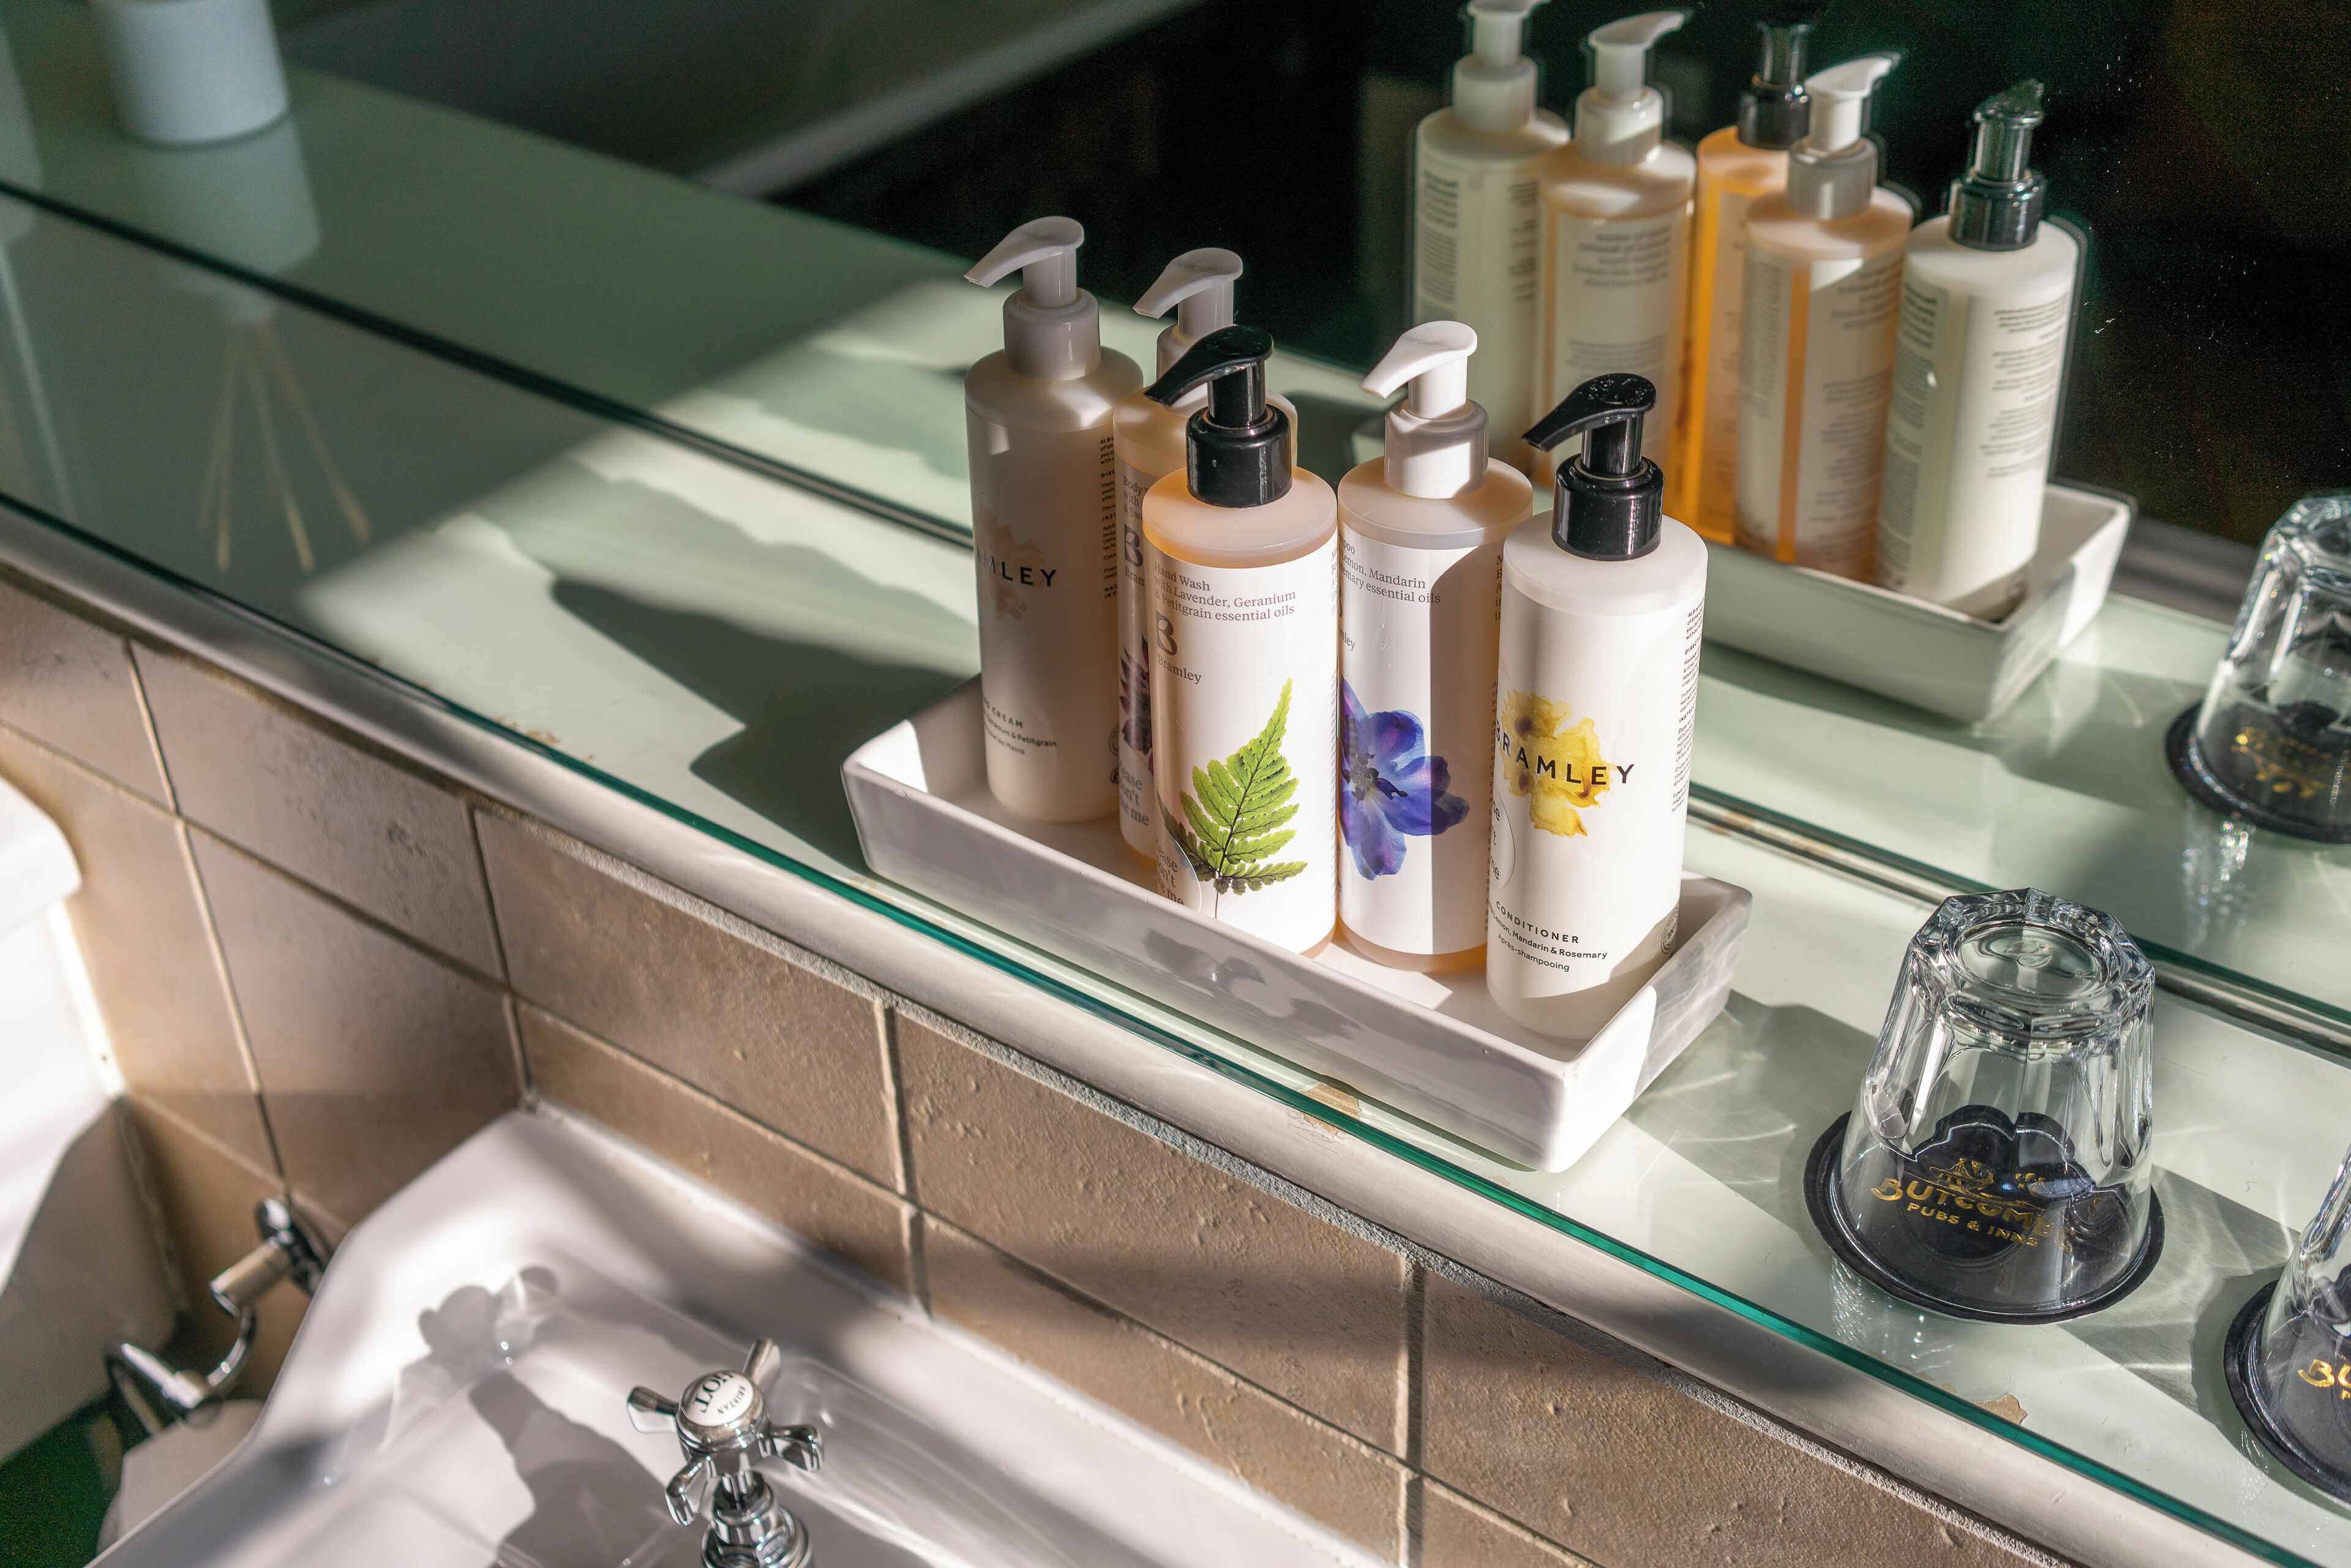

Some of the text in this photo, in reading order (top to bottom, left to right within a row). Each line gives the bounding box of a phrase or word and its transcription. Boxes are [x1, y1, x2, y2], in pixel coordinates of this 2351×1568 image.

[1123, 475, 1142, 496] Body
[1123, 490, 1139, 507] with
[1129, 507, 1142, 520] Sw
[1154, 561, 1210, 591] Hand Wash
[1341, 548, 1426, 589] Lemon, Mandarin
[1154, 577, 1296, 608] with Lavender, Geranium
[1155, 589, 1295, 621] & Petitgrain essential oils
[1365, 582, 1414, 602] essential
[1418, 591, 1441, 603] oils
[1158, 653, 1202, 685] Bramley
[992, 707, 1024, 729] CREAM
[1005, 741, 1026, 755] Mains
[1017, 734, 1057, 748] Petitgrain
[1496, 718, 1635, 786] BRAMLEY
[1120, 765, 1142, 790] ease
[1131, 808, 1150, 826] me
[1496, 901, 1580, 944] CONDITIONER
[1498, 932, 1570, 972] Après-shampooing
[1512, 929, 1549, 953] Mandarin
[1550, 947, 1557, 955] &
[1559, 948, 1608, 959] Rosemary
[1907, 1201, 2039, 1247] PUBS & INNS
[692, 1372, 734, 1414] HOT
